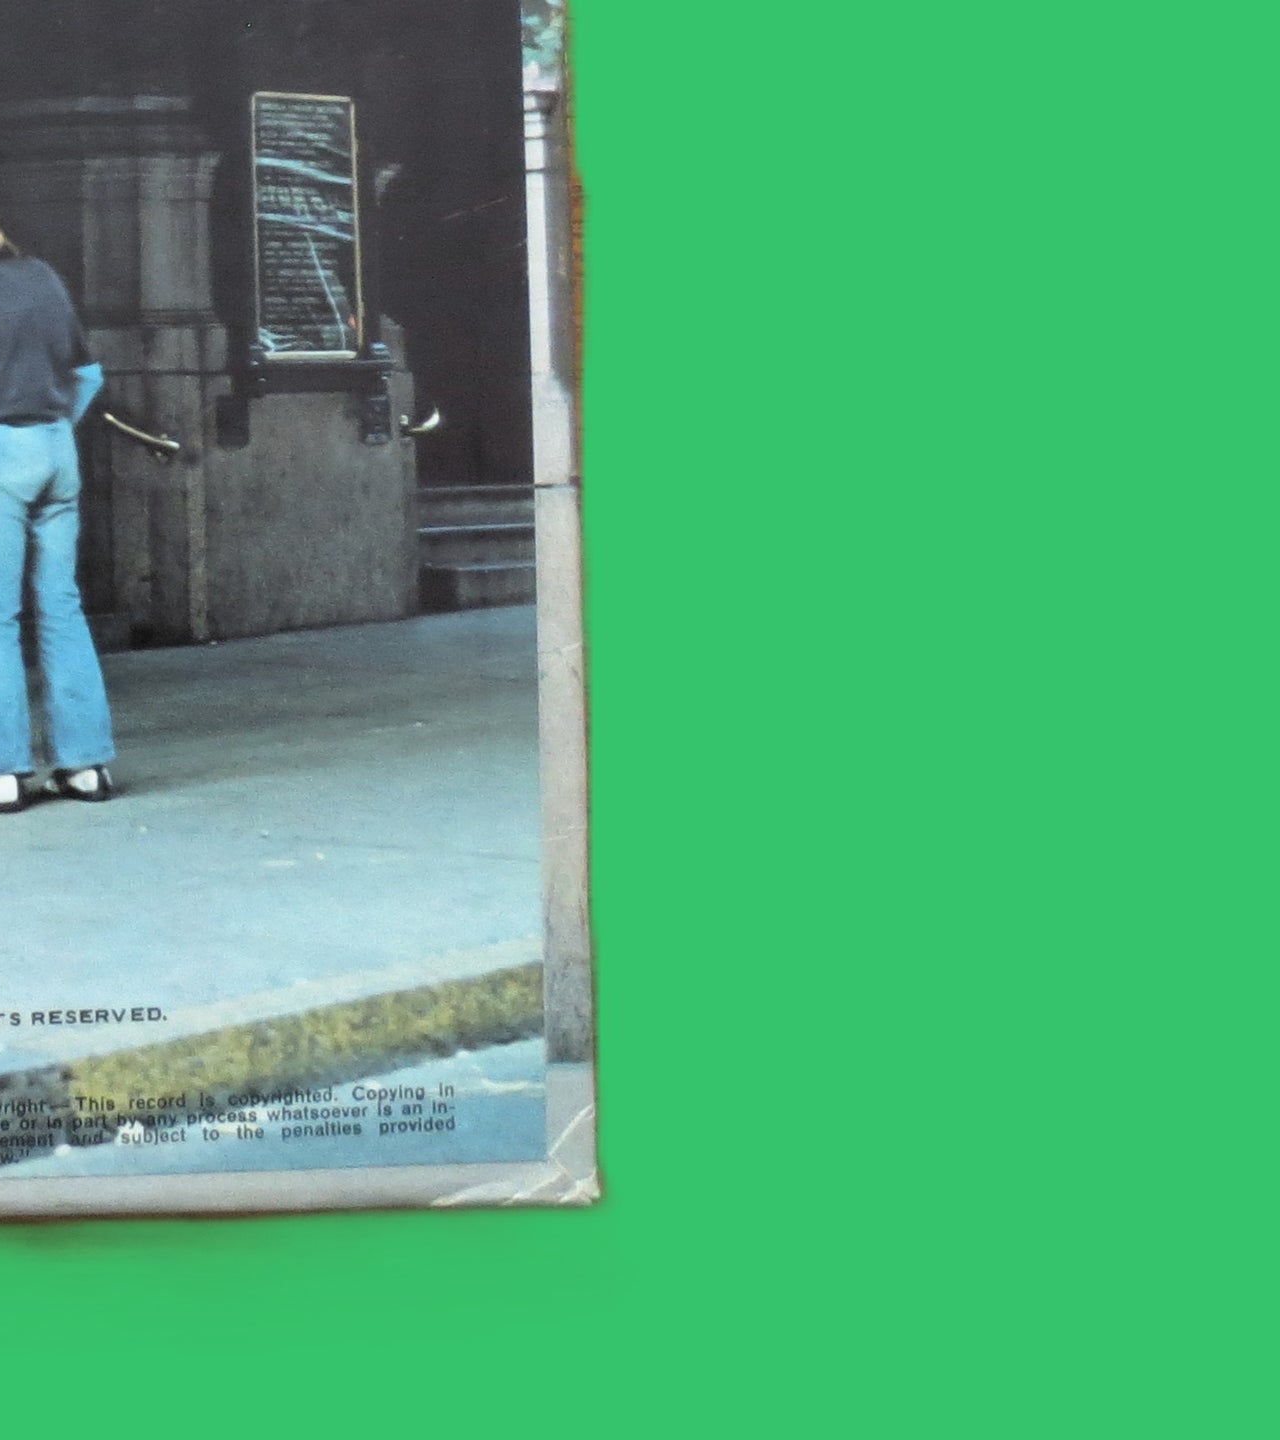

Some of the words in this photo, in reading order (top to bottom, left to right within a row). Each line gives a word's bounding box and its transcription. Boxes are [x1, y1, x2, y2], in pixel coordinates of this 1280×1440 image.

[30, 1006, 168, 1027] RESERVED.
[128, 1093, 187, 1110] record
[199, 1093, 215, 1108] is
[227, 1086, 339, 1109] copyrighted.
[351, 1083, 426, 1105] Copying
[439, 1082, 455, 1098] in
[19, 1118, 37, 1131] or
[47, 1115, 63, 1130] in
[72, 1114, 107, 1133] part
[116, 1112, 139, 1131] by
[146, 1114, 178, 1130] any
[187, 1110, 258, 1129] process
[267, 1104, 368, 1123] whatsoever
[378, 1102, 392, 1118] is
[401, 1103, 423, 1117] an
[71, 1129, 104, 1146] and
[120, 1127, 187, 1147] subject
[203, 1127, 220, 1142] to
[237, 1125, 265, 1141] the
[281, 1121, 363, 1141] penalties
[379, 1116, 456, 1137] provided
